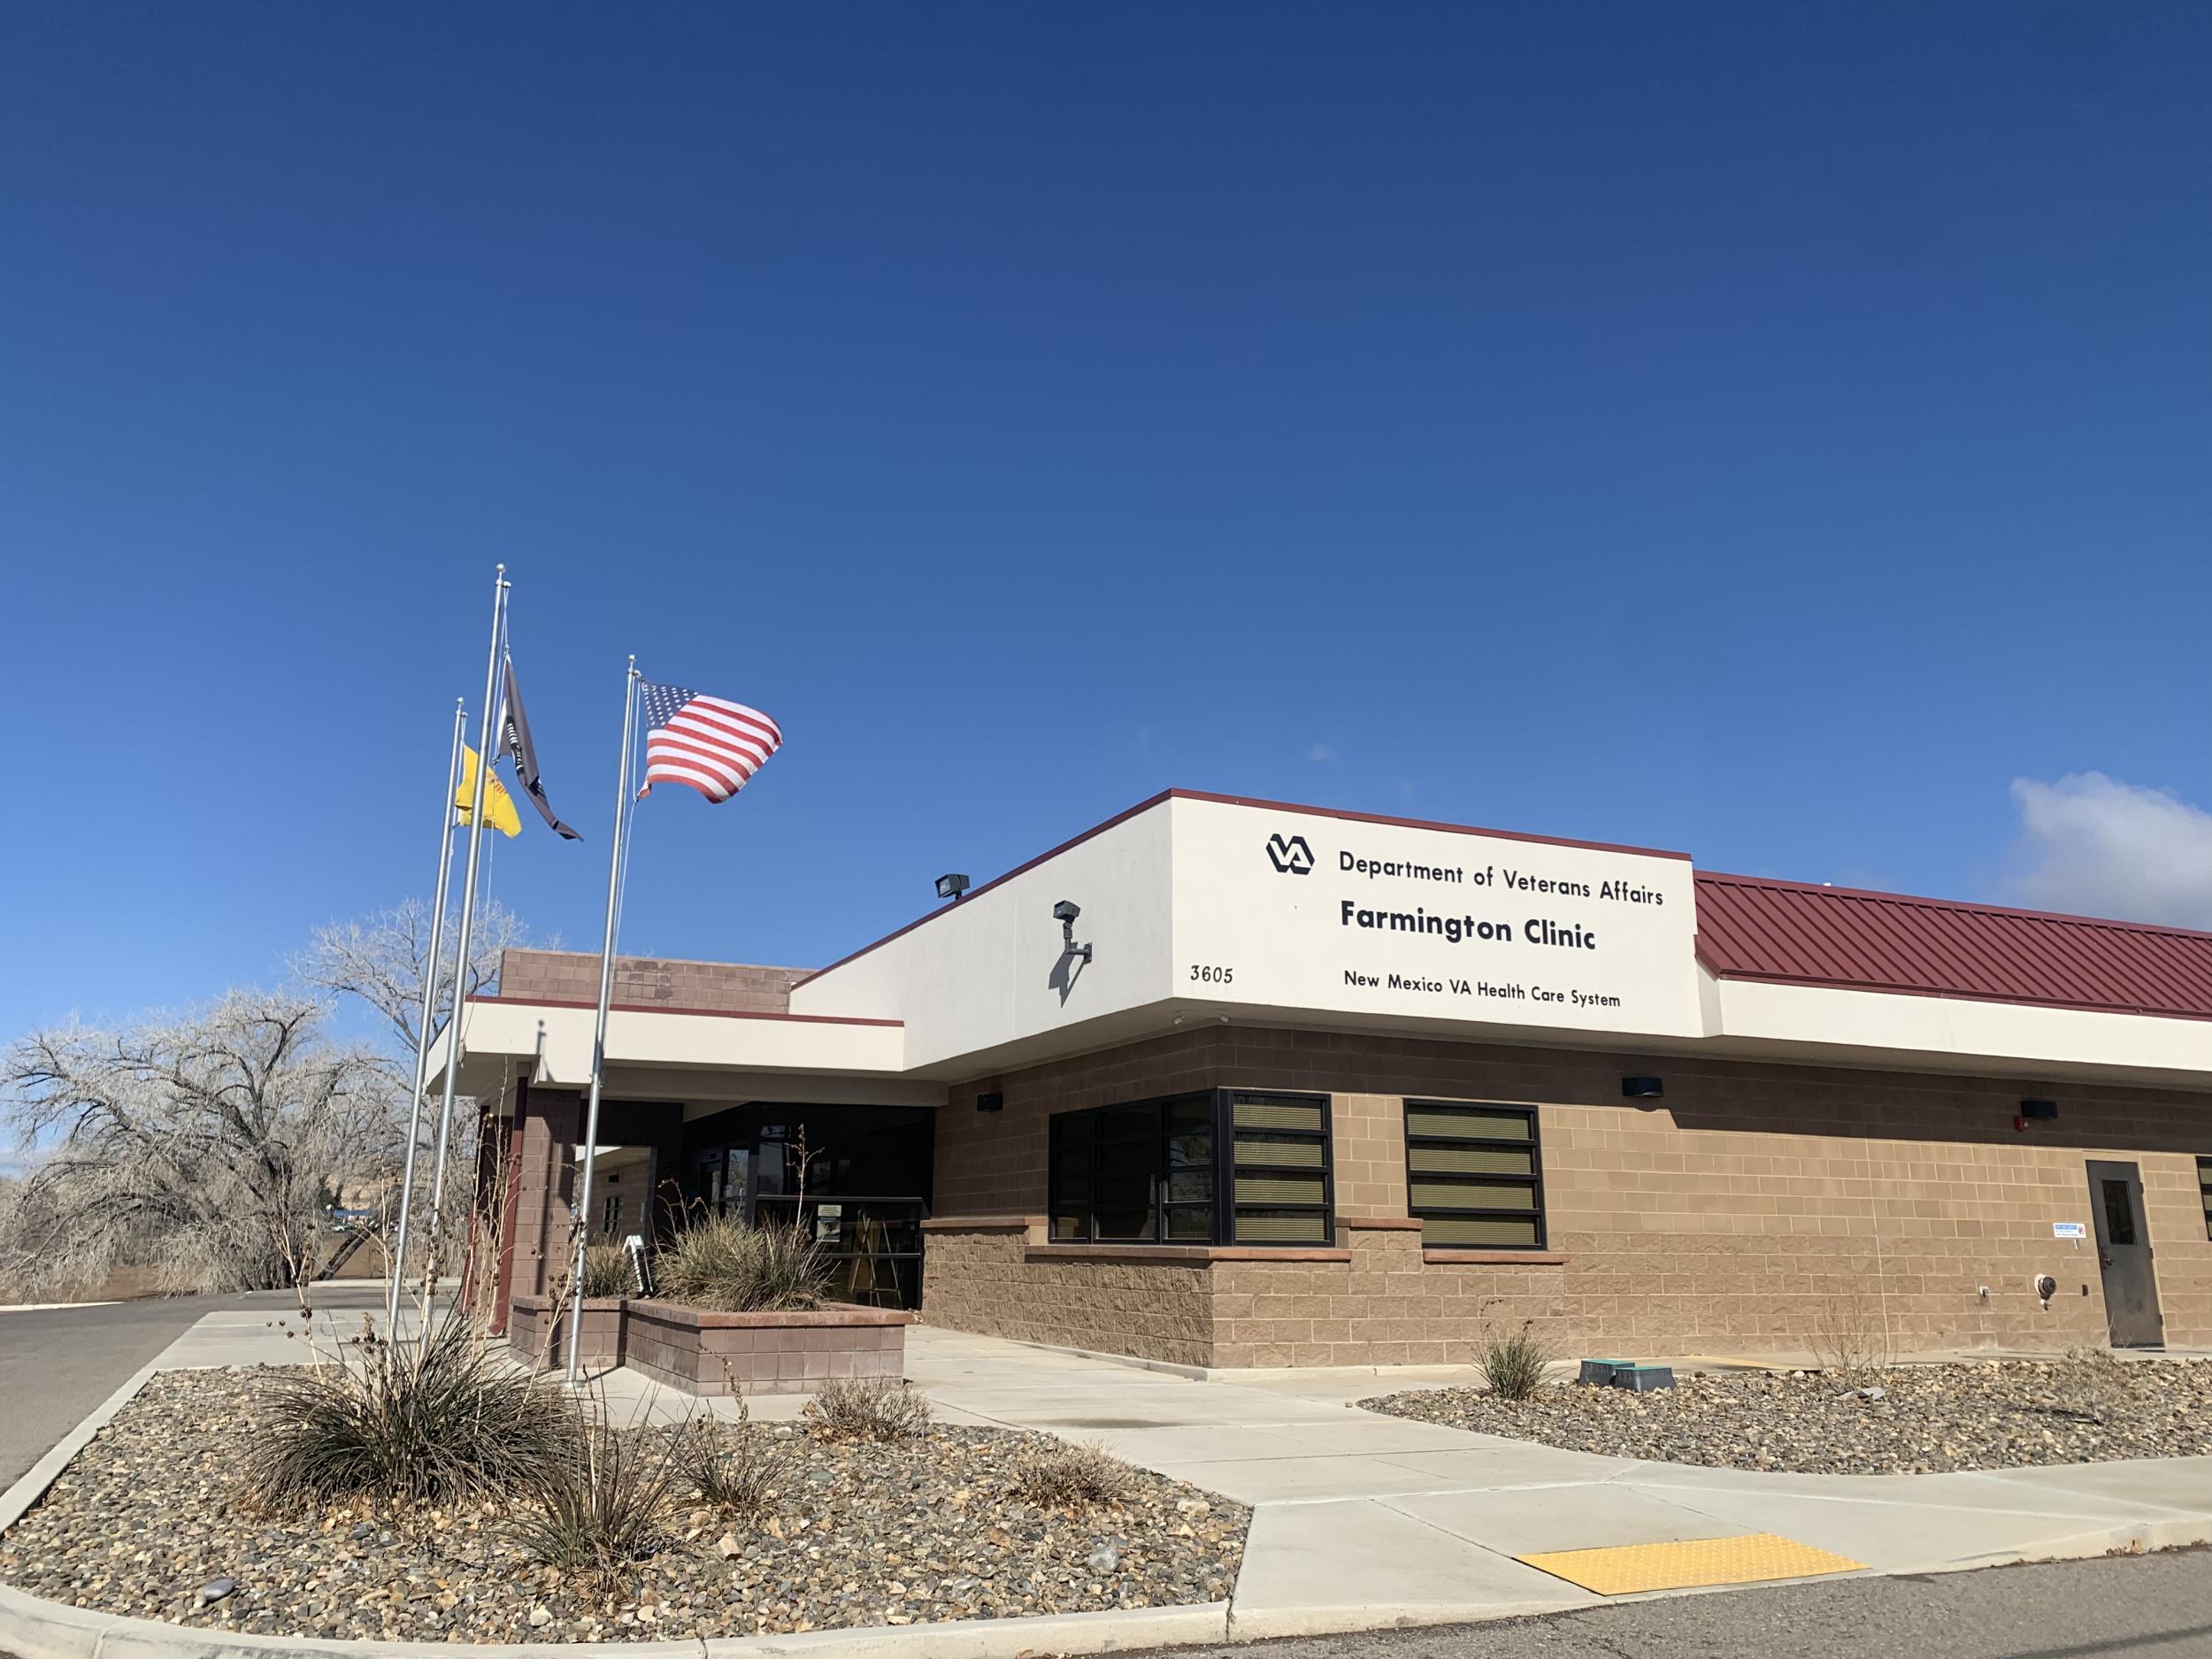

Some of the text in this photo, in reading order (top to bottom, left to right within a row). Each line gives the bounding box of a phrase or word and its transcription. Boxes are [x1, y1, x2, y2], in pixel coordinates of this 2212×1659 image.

[1266, 833, 1315, 875] VA
[1340, 850, 1663, 906] Department of Veterans Affairs
[1340, 900, 1596, 950] Farmington Clinic
[1190, 964, 1233, 984] 3605
[1344, 970, 1621, 1008] New Mexico VA Health Care System
